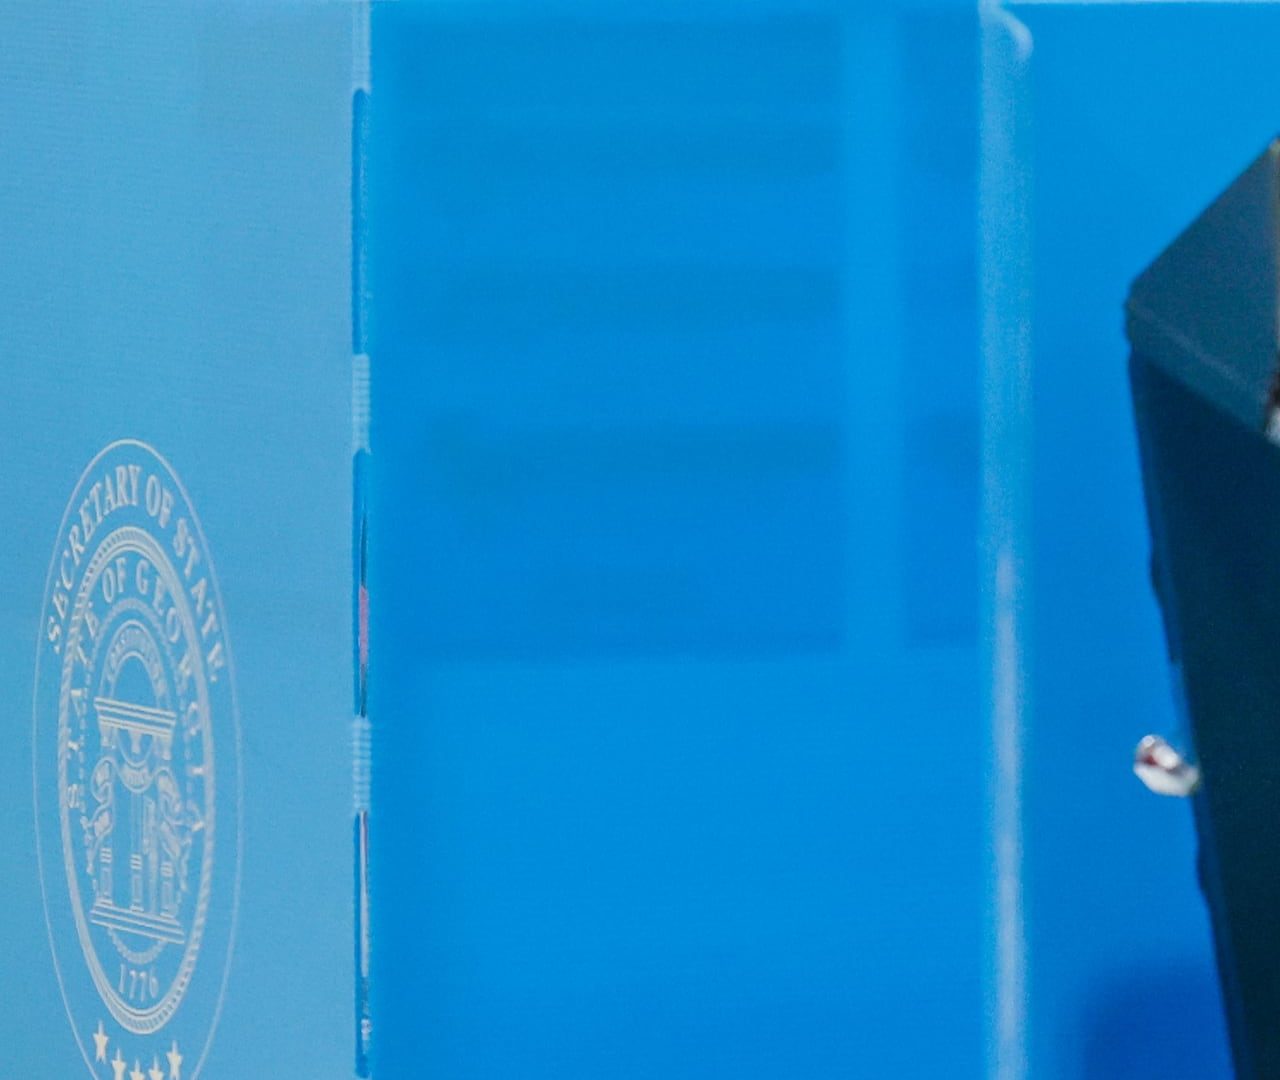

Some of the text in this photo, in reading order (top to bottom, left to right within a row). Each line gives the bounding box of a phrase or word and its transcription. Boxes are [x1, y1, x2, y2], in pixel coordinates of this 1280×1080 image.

[47, 463, 142, 655] SECRETARY
[145, 474, 175, 529] OF
[172, 517, 224, 682] STATE
[101, 556, 127, 604] OF
[118, 963, 160, 1002] 1776
